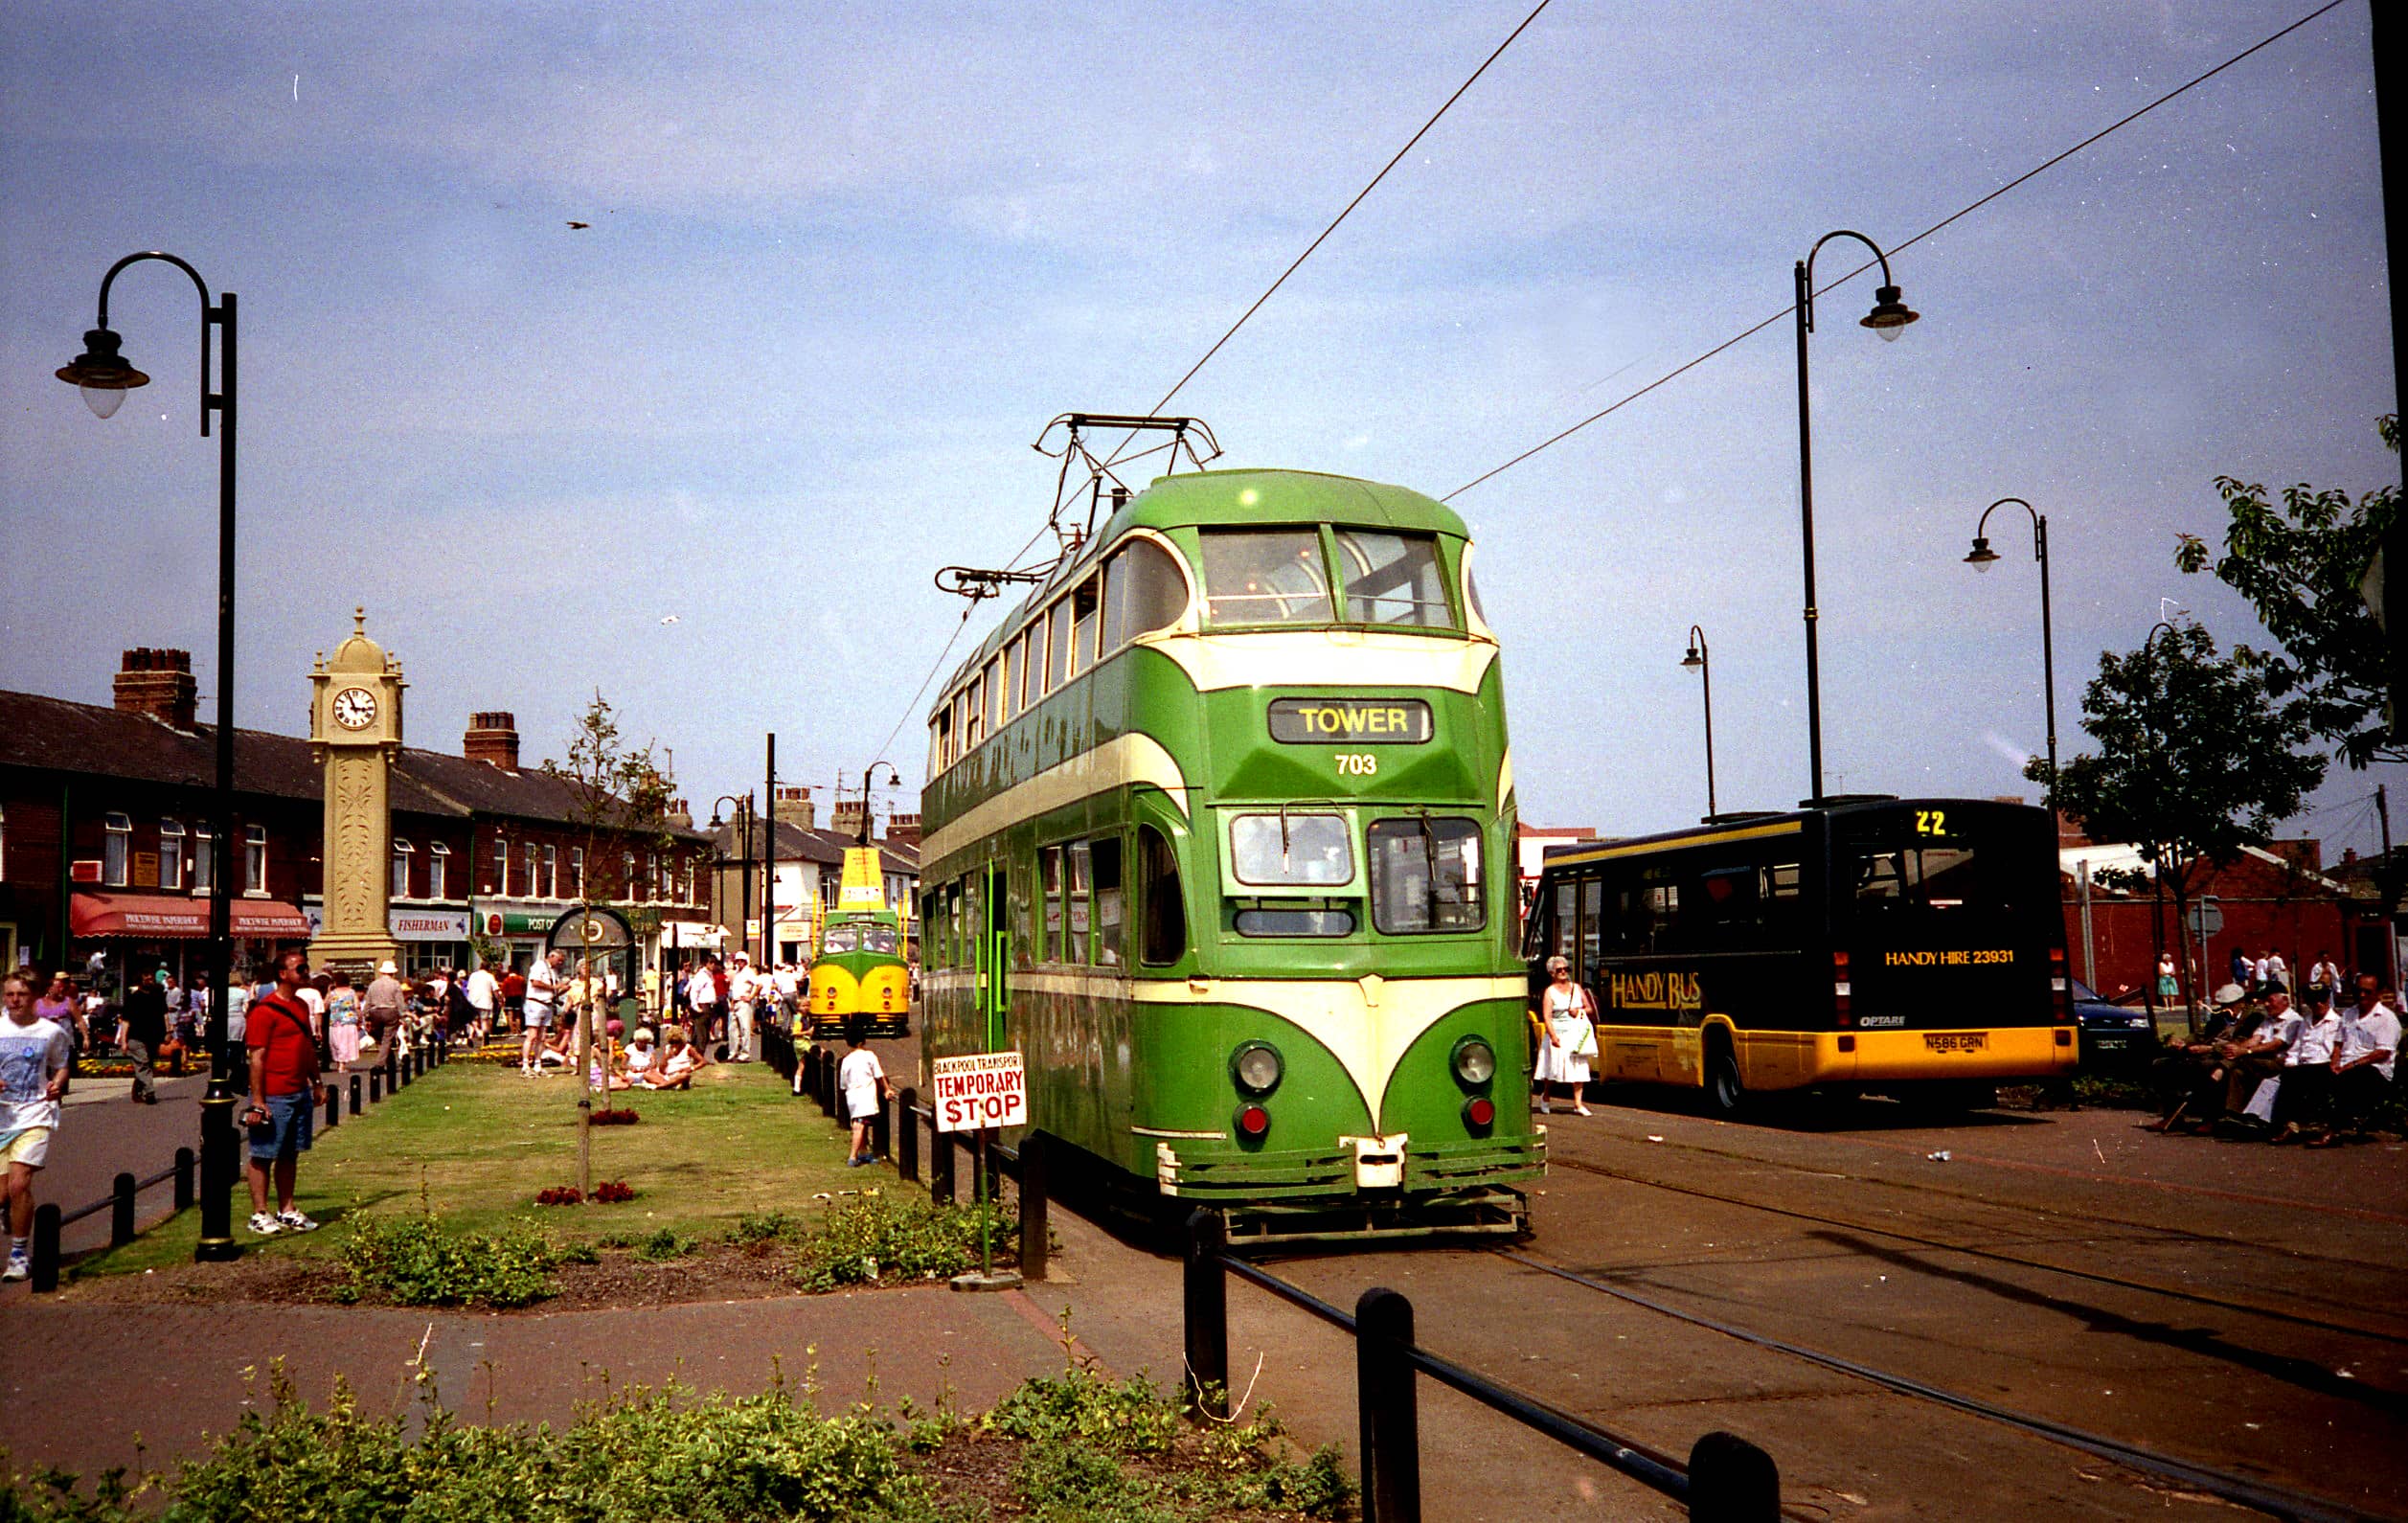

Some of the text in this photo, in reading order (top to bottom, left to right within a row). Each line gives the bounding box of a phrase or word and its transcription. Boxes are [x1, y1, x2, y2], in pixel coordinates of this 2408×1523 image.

[1299, 708, 1408, 733] TOWER
[1334, 754, 1376, 775] 703
[398, 919, 449, 931] FISHERMAN
[528, 919, 546, 930] POST
[1885, 949, 2013, 966] HANDY HIRE 23931
[1611, 972, 1701, 1010] HANDY BUS
[1859, 1015, 1905, 1027] OPTARE
[1926, 1036, 1983, 1049] N586 GRN
[935, 1056, 1022, 1074] BLACKPOOL TRANSPORT
[937, 1071, 1022, 1098] TEMPORARY
[945, 1094, 1020, 1123] STOP
